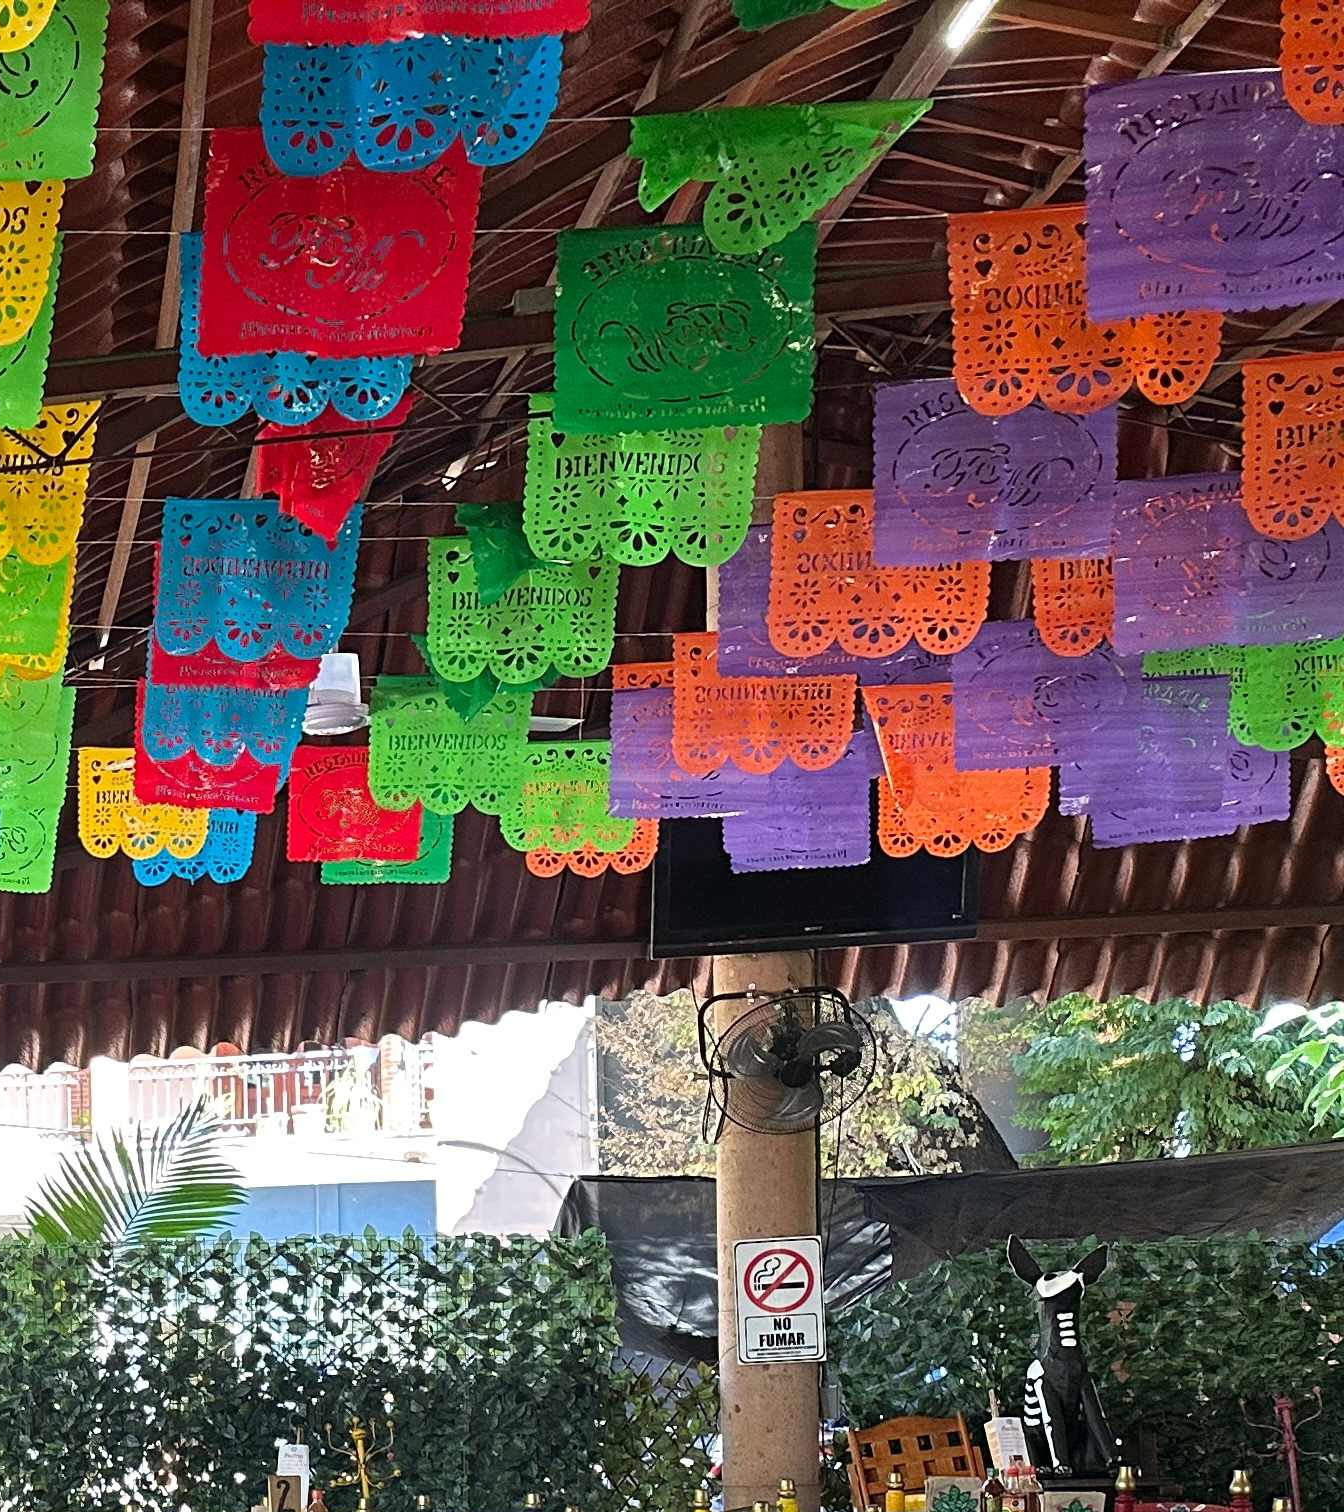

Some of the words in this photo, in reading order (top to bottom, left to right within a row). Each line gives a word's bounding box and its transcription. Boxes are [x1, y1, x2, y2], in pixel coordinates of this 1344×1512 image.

[1120, 79, 1275, 144] RESTAUR
[555, 452, 727, 480] BIENVENIDOS
[388, 733, 509, 752] BIENVENIDOS
[773, 1317, 792, 1331] NO
[759, 1332, 806, 1347] FUMAR
